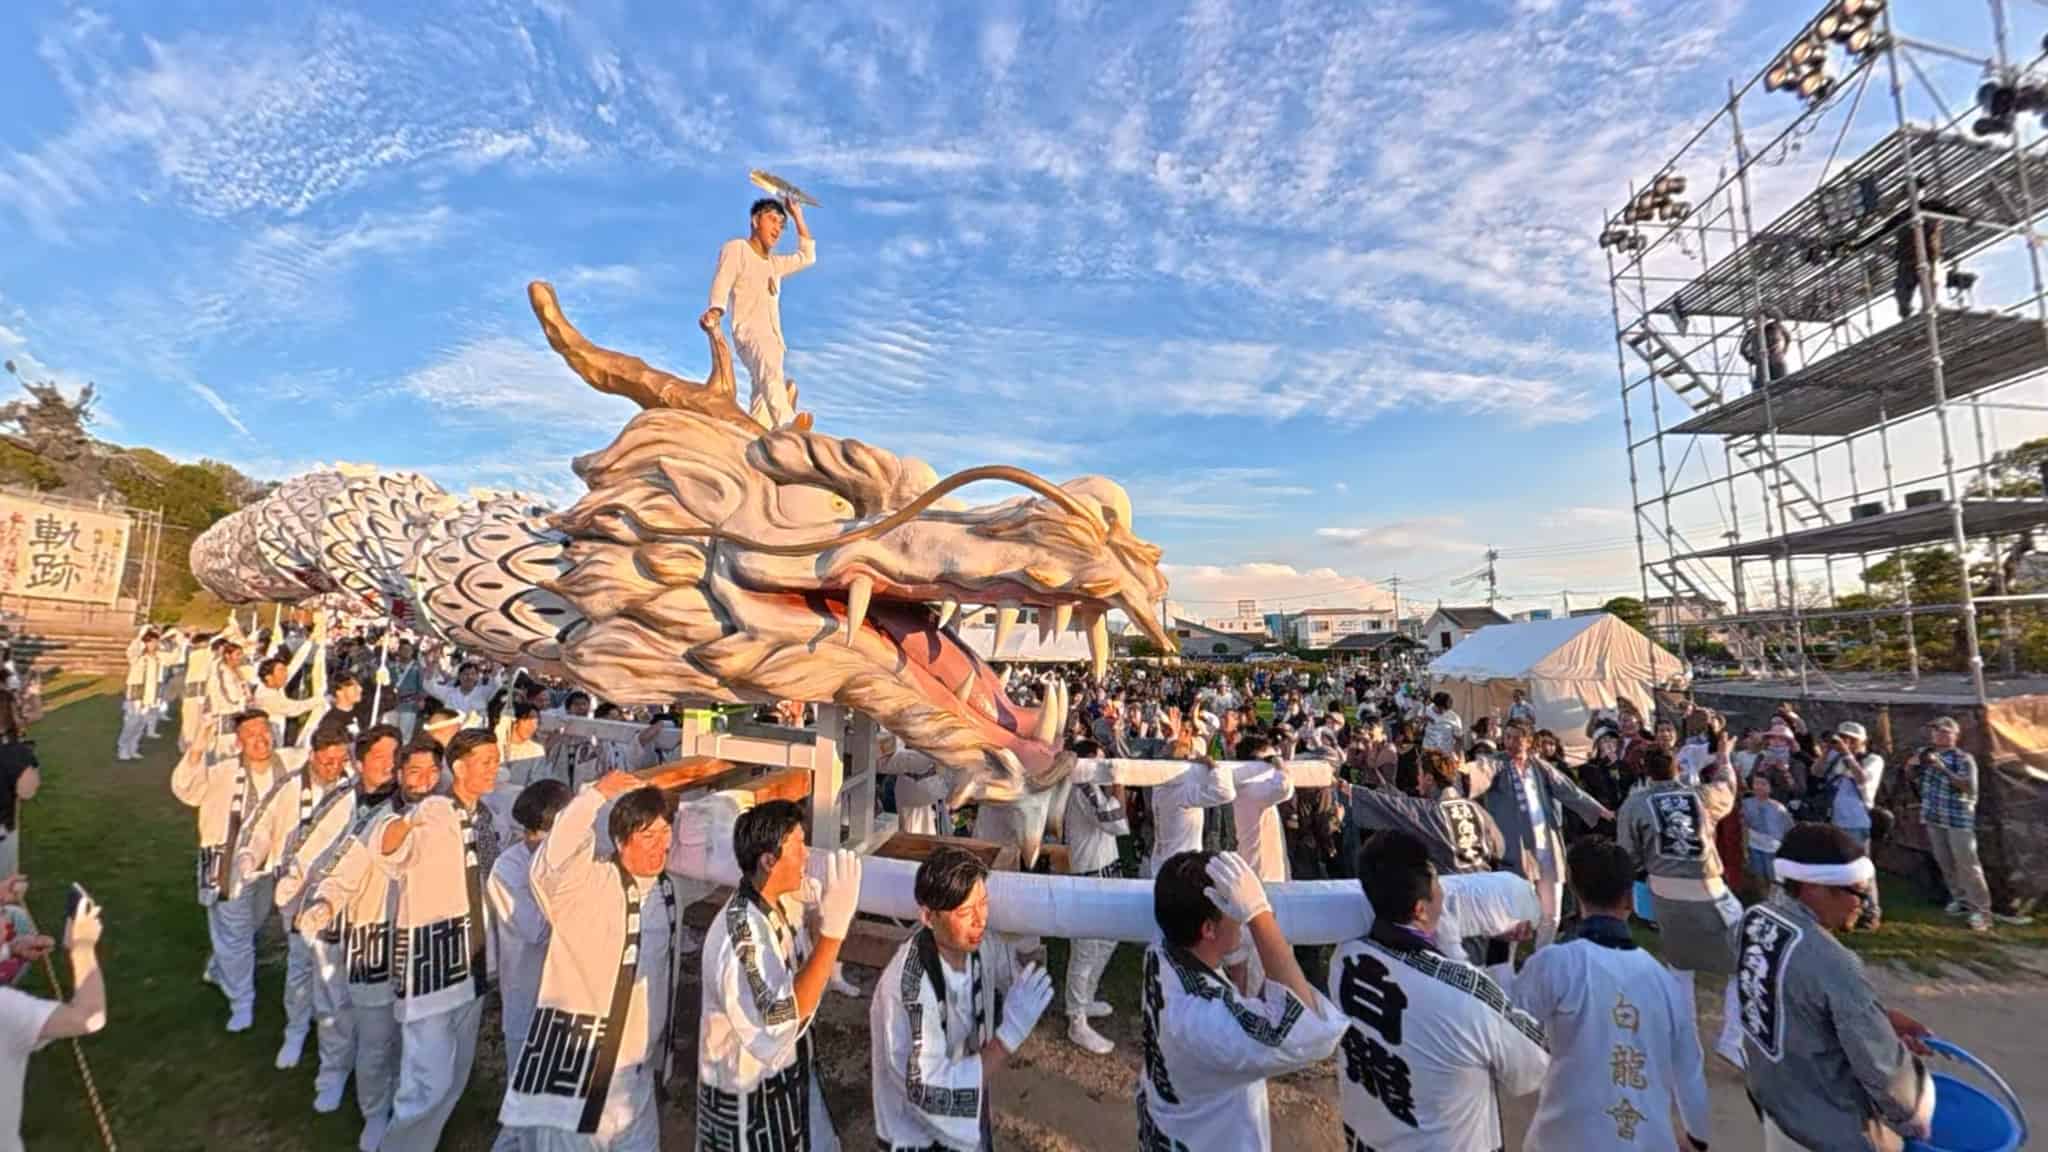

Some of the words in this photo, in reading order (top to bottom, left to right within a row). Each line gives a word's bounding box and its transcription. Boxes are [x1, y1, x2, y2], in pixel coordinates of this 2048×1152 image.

[25, 513, 84, 592] 軌跡
[1604, 989, 1649, 1143] 白龍會
